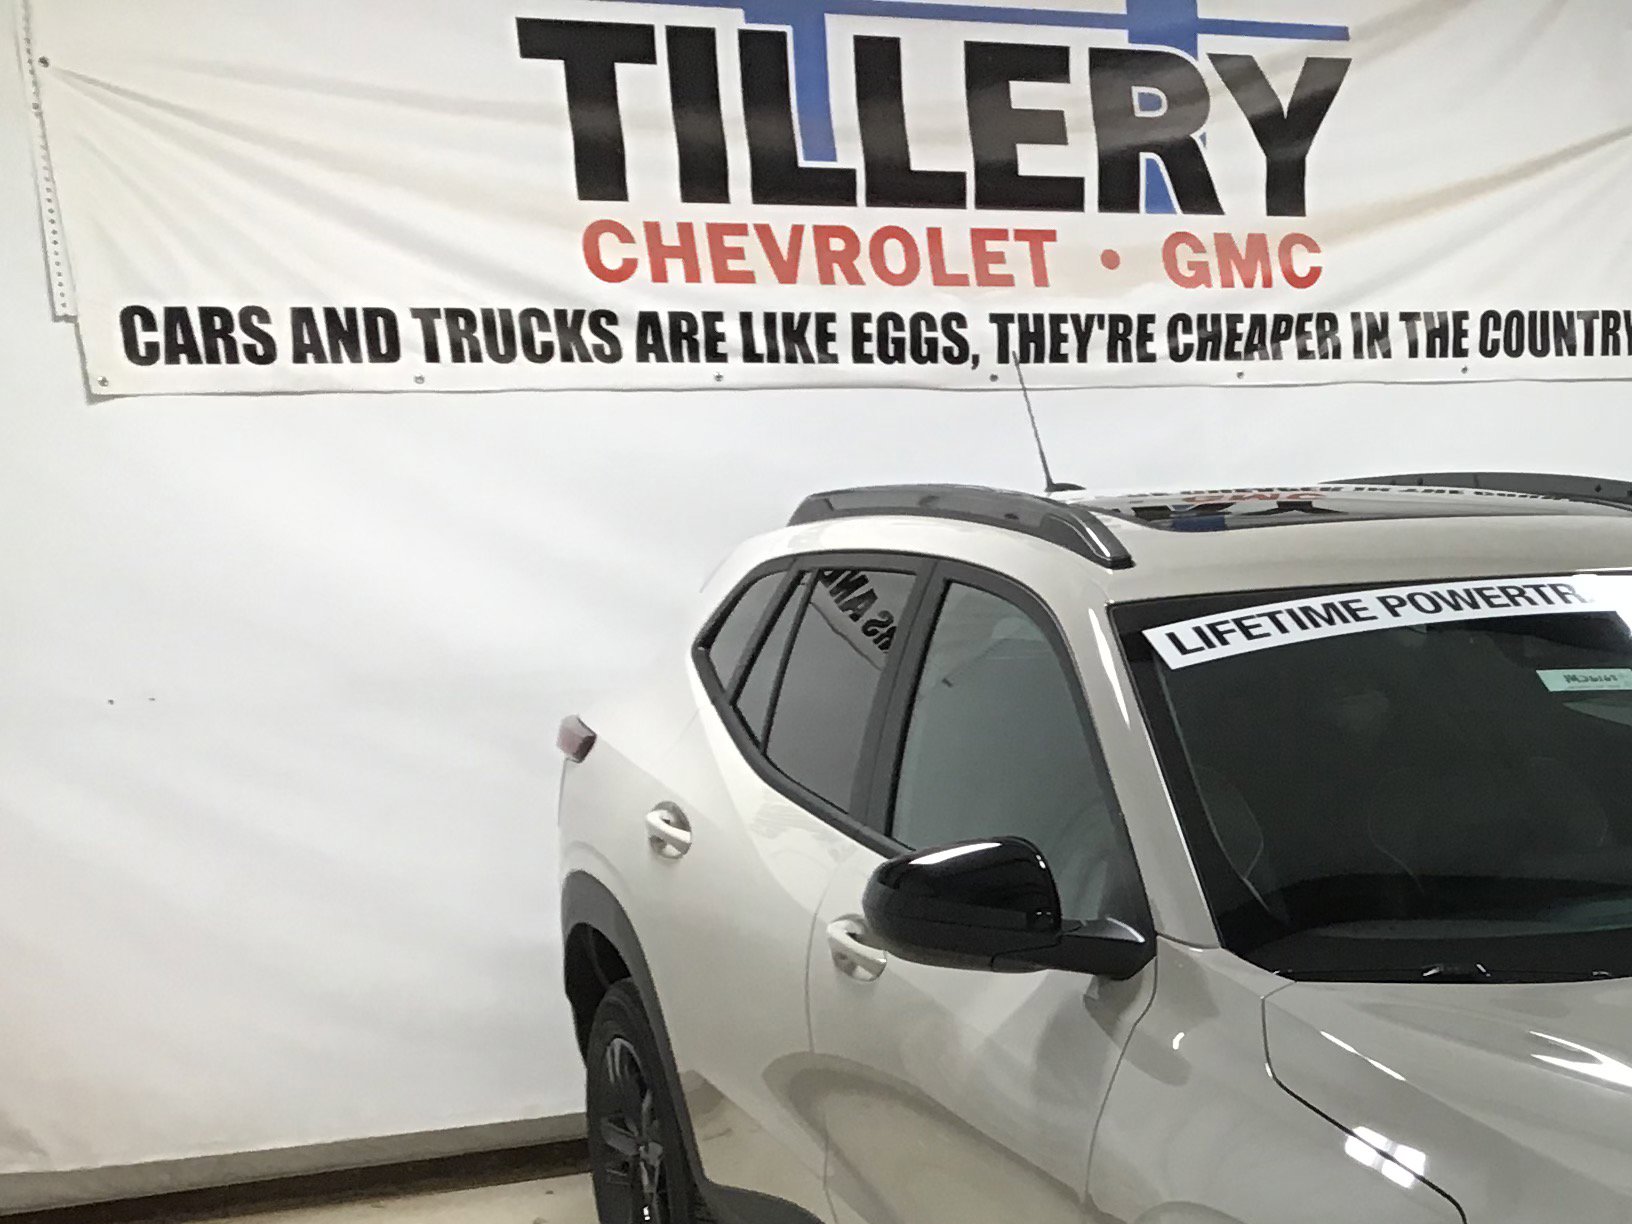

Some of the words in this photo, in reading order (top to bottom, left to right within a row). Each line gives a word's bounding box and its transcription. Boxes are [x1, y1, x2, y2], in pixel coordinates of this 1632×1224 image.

[517, 17, 1351, 217] TILLERY
[582, 219, 1057, 288] CHEVROLET
[1161, 231, 1323, 289] GMC
[120, 304, 278, 366] CARS
[291, 306, 401, 365] AND
[410, 307, 622, 365] TRUCKS
[636, 310, 727, 364] ARE
[740, 311, 837, 364] LIKE
[851, 311, 980, 369] EGGS,
[989, 311, 1157, 365] THEY'RE
[1168, 311, 1340, 363] CHEAPER
[1351, 310, 1391, 360] IN
[1398, 310, 1469, 359] THE
[1164, 597, 1380, 656] LIFETIME
[1385, 582, 1596, 629] POWERTR
